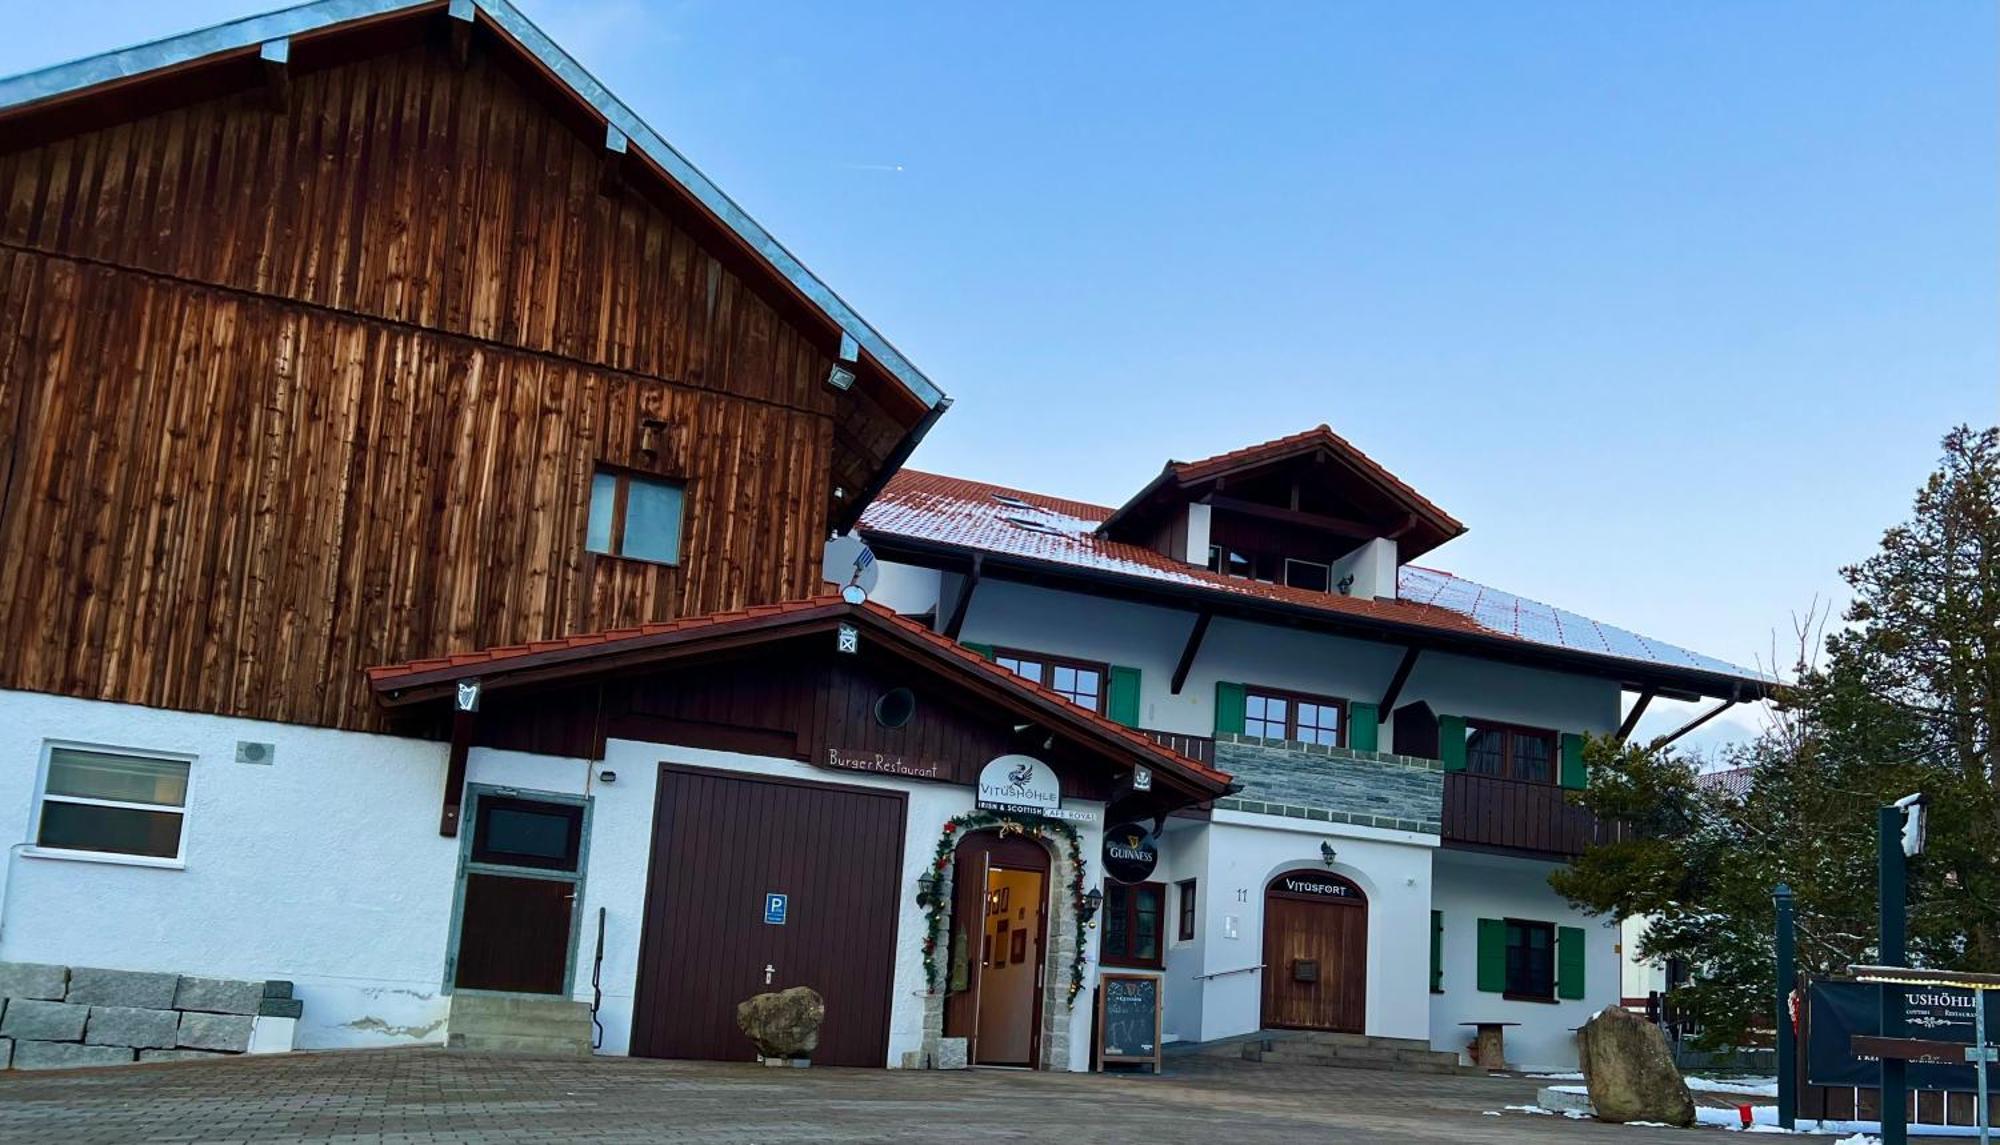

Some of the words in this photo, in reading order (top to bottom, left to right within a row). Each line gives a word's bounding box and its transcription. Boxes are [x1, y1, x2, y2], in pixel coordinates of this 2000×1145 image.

[978, 801, 998, 810] IRISH
[1007, 805, 1042, 815] SCOTTISH
[1110, 847, 1153, 862] GUINNESS
[1236, 888, 1248, 903] 11
[772, 898, 782, 912] P
[1905, 993, 1977, 1007] USHÖHLE
